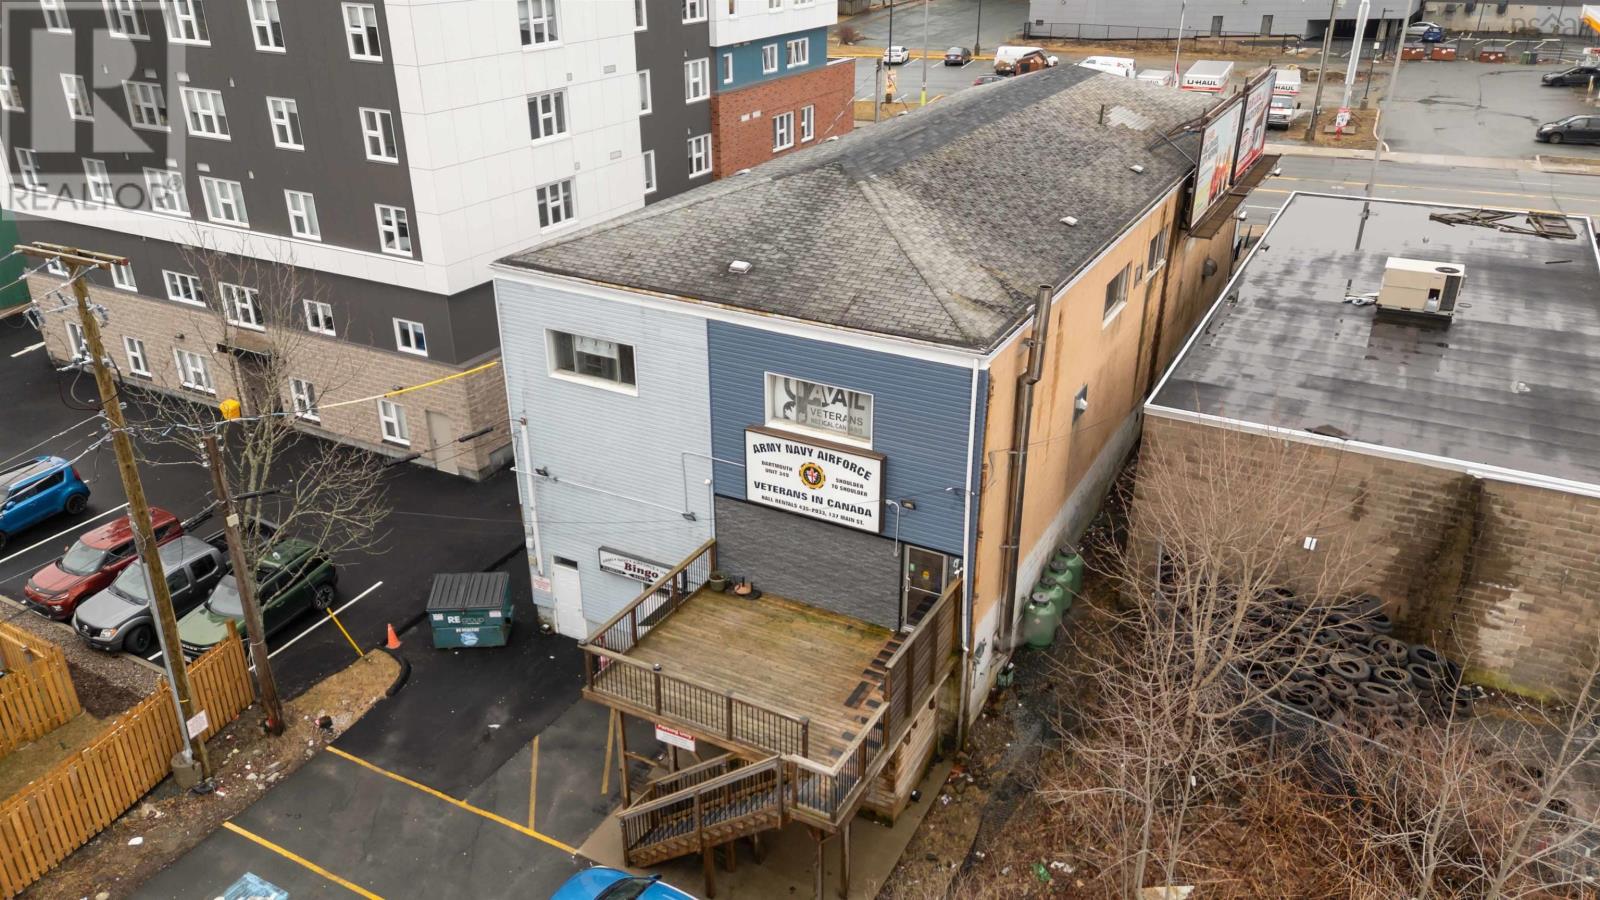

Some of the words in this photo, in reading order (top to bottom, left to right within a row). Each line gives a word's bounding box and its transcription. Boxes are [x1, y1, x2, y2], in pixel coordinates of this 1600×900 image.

[810, 407, 864, 426] VETERANS
[753, 442, 781, 454] ARMY
[785, 444, 813, 457] NAVY
[817, 450, 872, 481] AIRFORCE
[754, 480, 808, 501] VETERANS
[811, 495, 824, 505] IN
[827, 499, 872, 517] CANADA
[624, 562, 659, 579] Bingo
